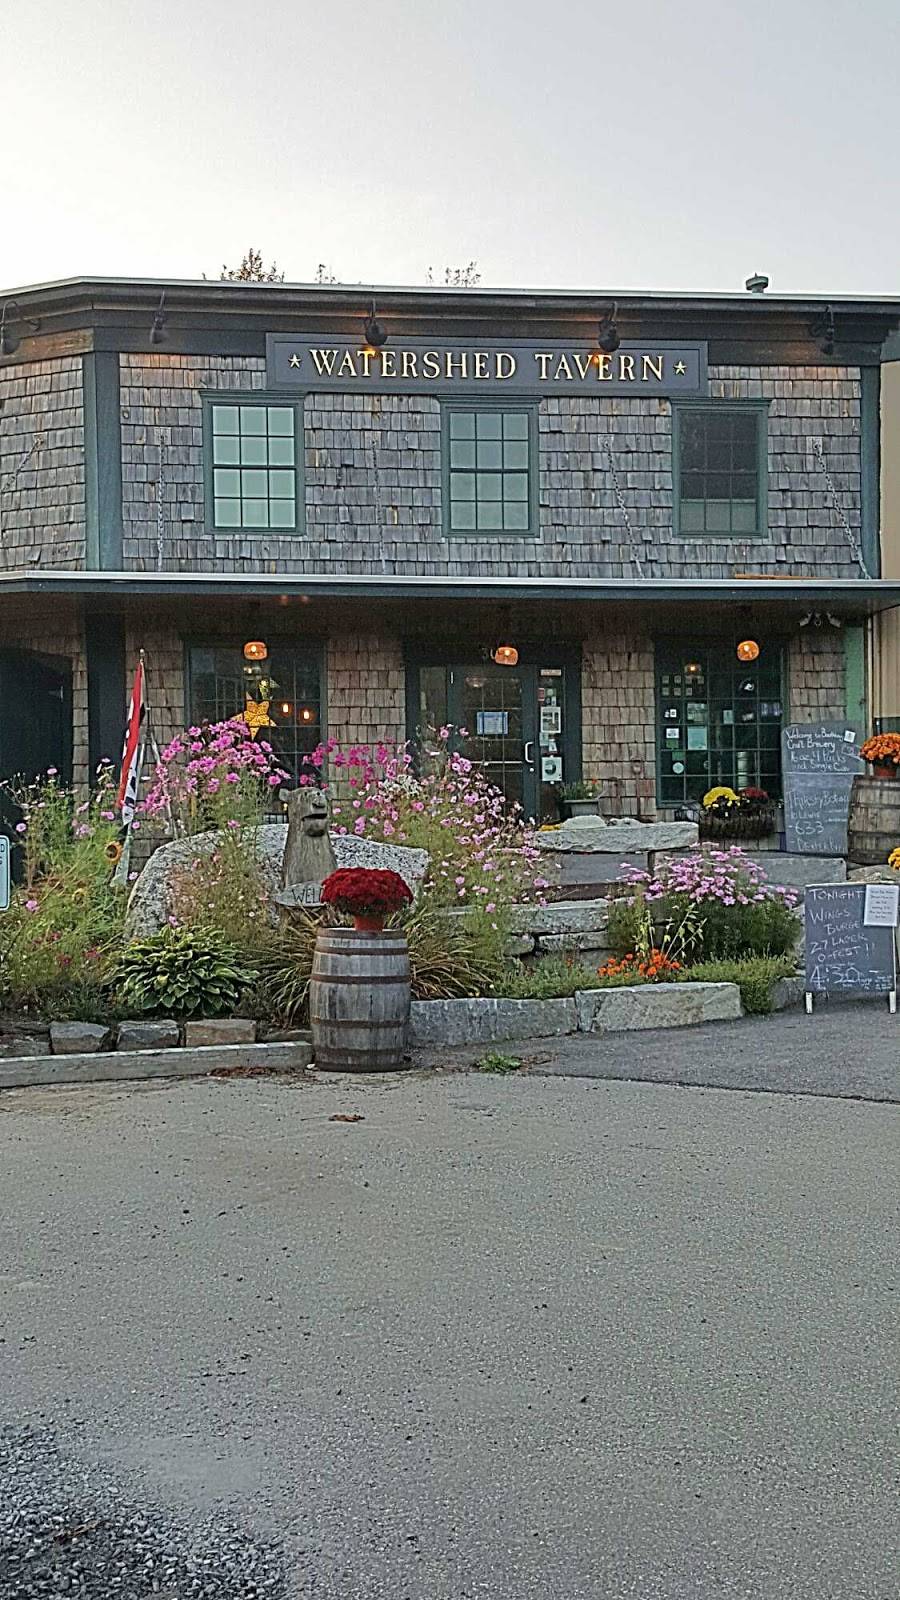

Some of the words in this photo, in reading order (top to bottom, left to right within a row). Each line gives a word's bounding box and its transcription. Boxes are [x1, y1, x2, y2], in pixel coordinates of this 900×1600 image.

[309, 348, 517, 379] WATERSHED
[534, 353, 664, 381] TAVERN
[807, 737, 836, 753] Brewery
[292, 887, 322, 903] WEL
[808, 888, 865, 901] TONIGHT
[809, 907, 851, 925] WINGS
